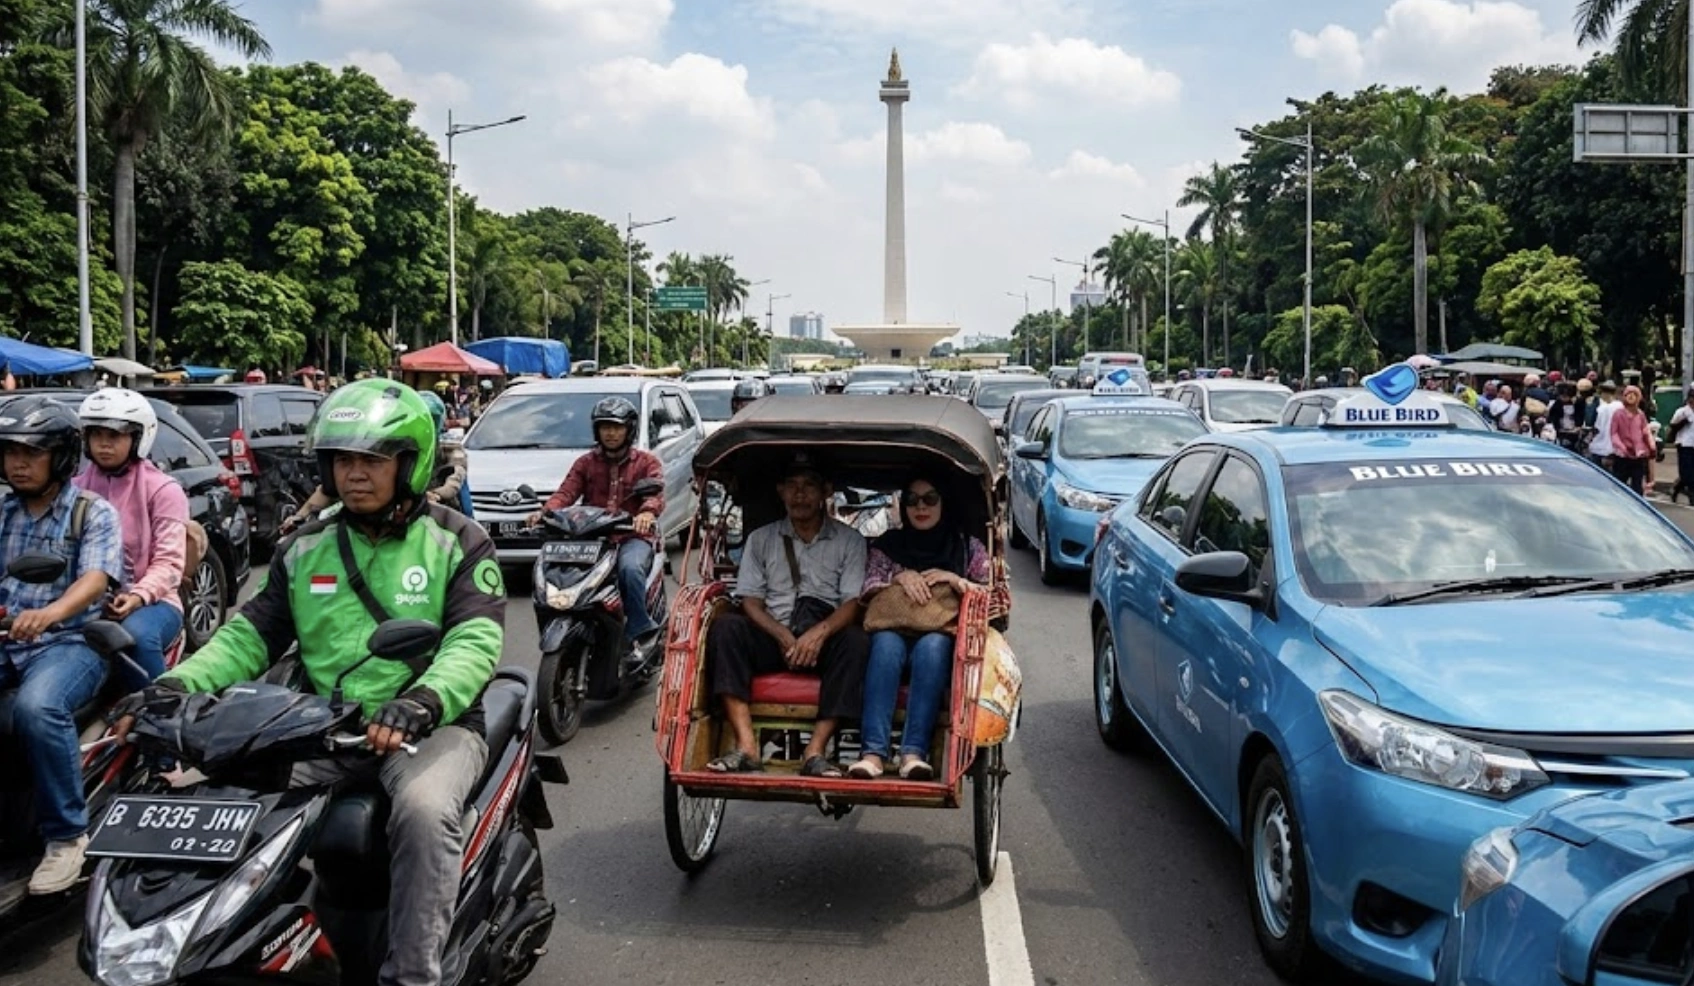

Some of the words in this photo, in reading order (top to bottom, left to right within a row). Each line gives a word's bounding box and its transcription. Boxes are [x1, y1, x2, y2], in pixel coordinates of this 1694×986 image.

[1346, 408, 1391, 421] BLUE
[1396, 408, 1440, 421] BIRD
[1350, 464, 1447, 481] BLUE
[1449, 462, 1543, 476] BIRD
[106, 804, 128, 826] B
[138, 805, 199, 829] 6335
